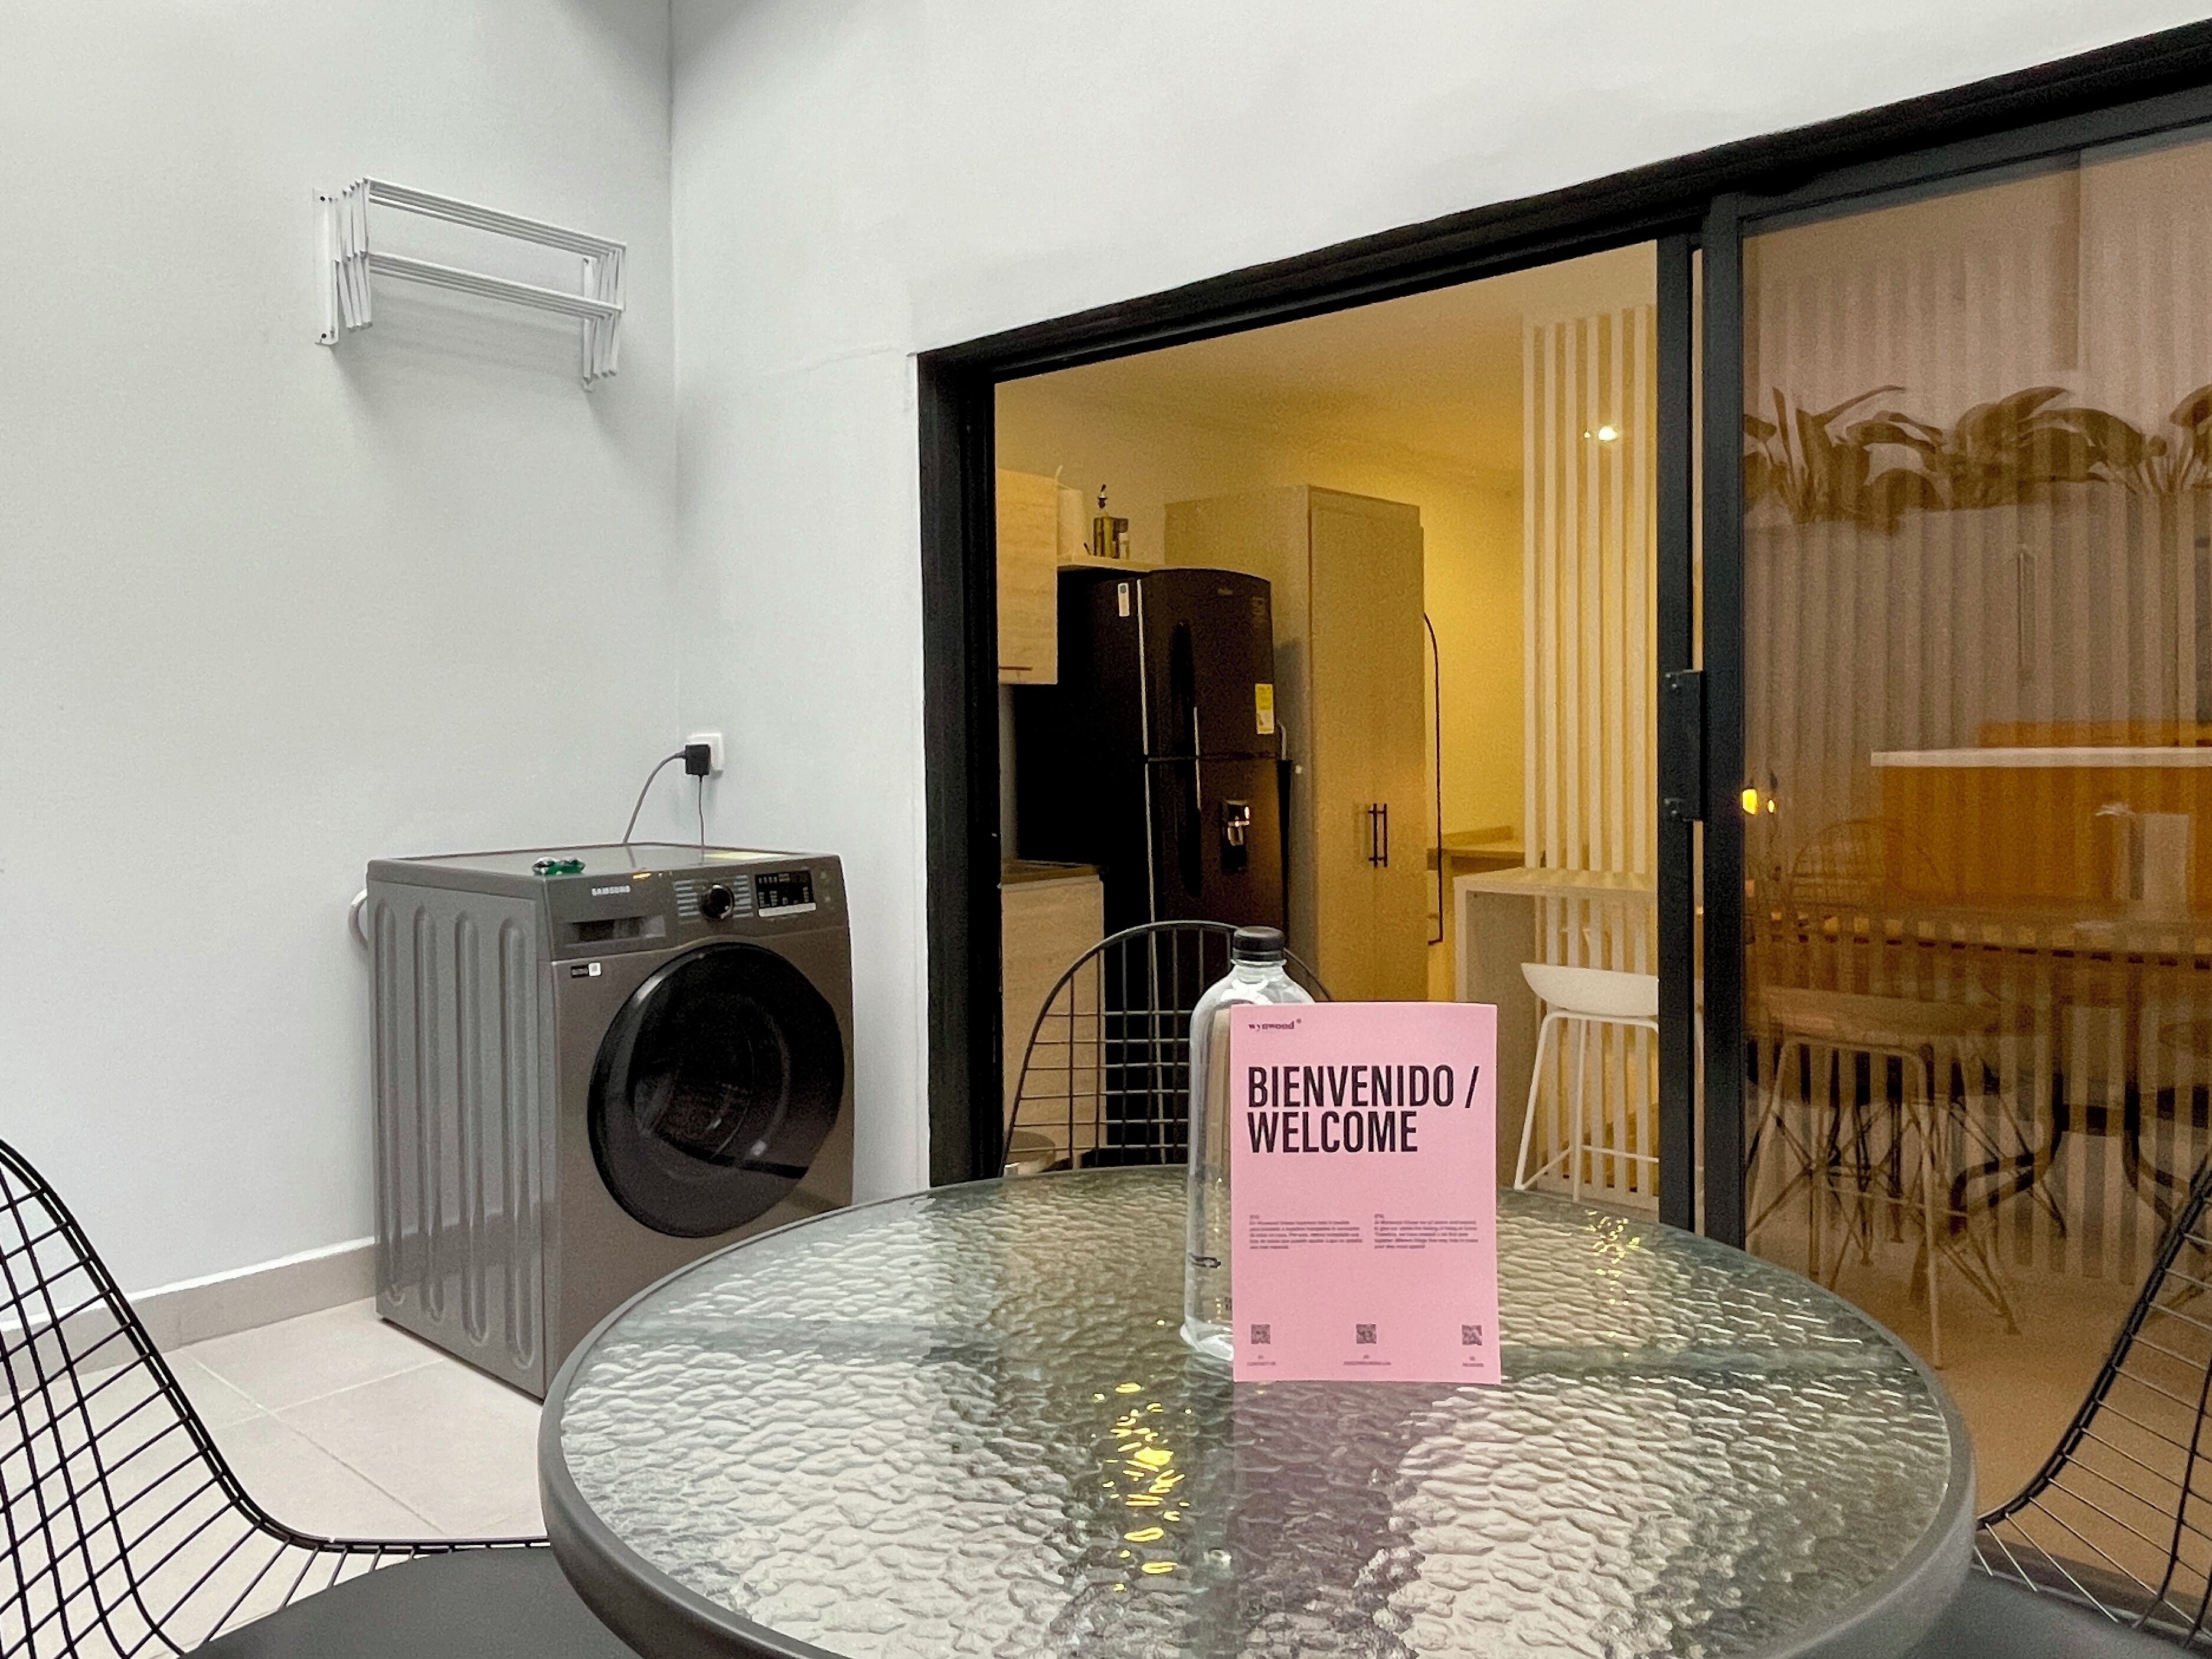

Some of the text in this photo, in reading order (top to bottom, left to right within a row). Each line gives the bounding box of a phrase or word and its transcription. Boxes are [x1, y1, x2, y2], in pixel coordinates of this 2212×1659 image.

[1248, 1064, 1480, 1109] BIENVENIDO /
[1247, 1110, 1419, 1154] WELCOME
